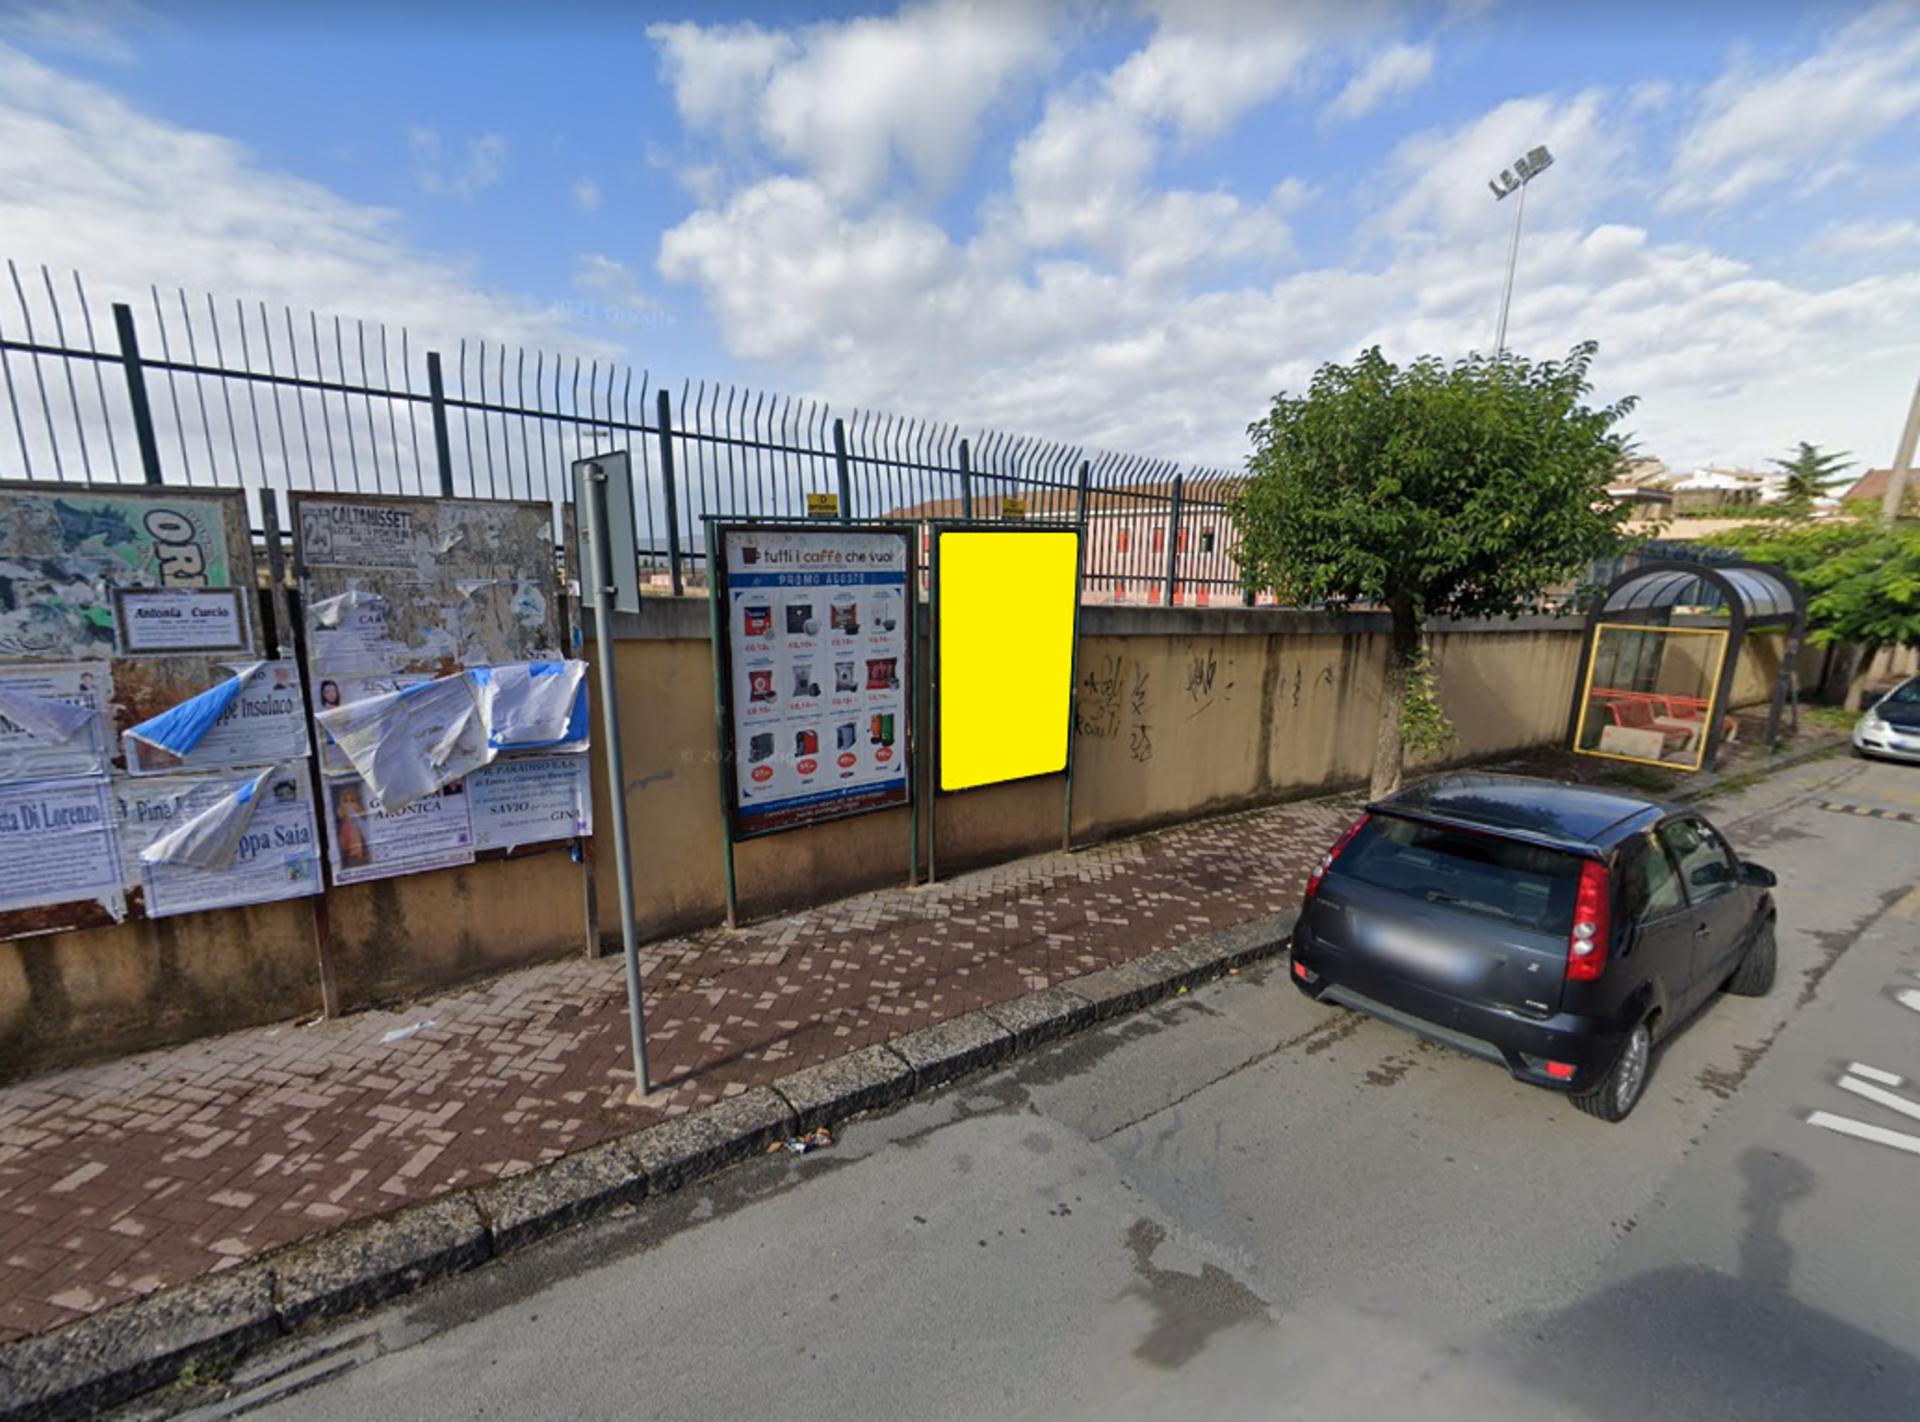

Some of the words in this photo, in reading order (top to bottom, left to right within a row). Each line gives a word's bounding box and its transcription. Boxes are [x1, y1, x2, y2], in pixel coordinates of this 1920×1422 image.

[332, 506, 412, 528] CALTANISSET
[764, 549, 793, 563] tutti
[845, 549, 866, 562] che
[779, 574, 820, 586] PROMO
[135, 607, 182, 619] Antonia
[191, 606, 230, 618] Curcio
[489, 801, 529, 815] SAVIO
[20, 802, 41, 831] Di
[41, 801, 100, 828] Lorenzo
[273, 822, 309, 849] Saia
